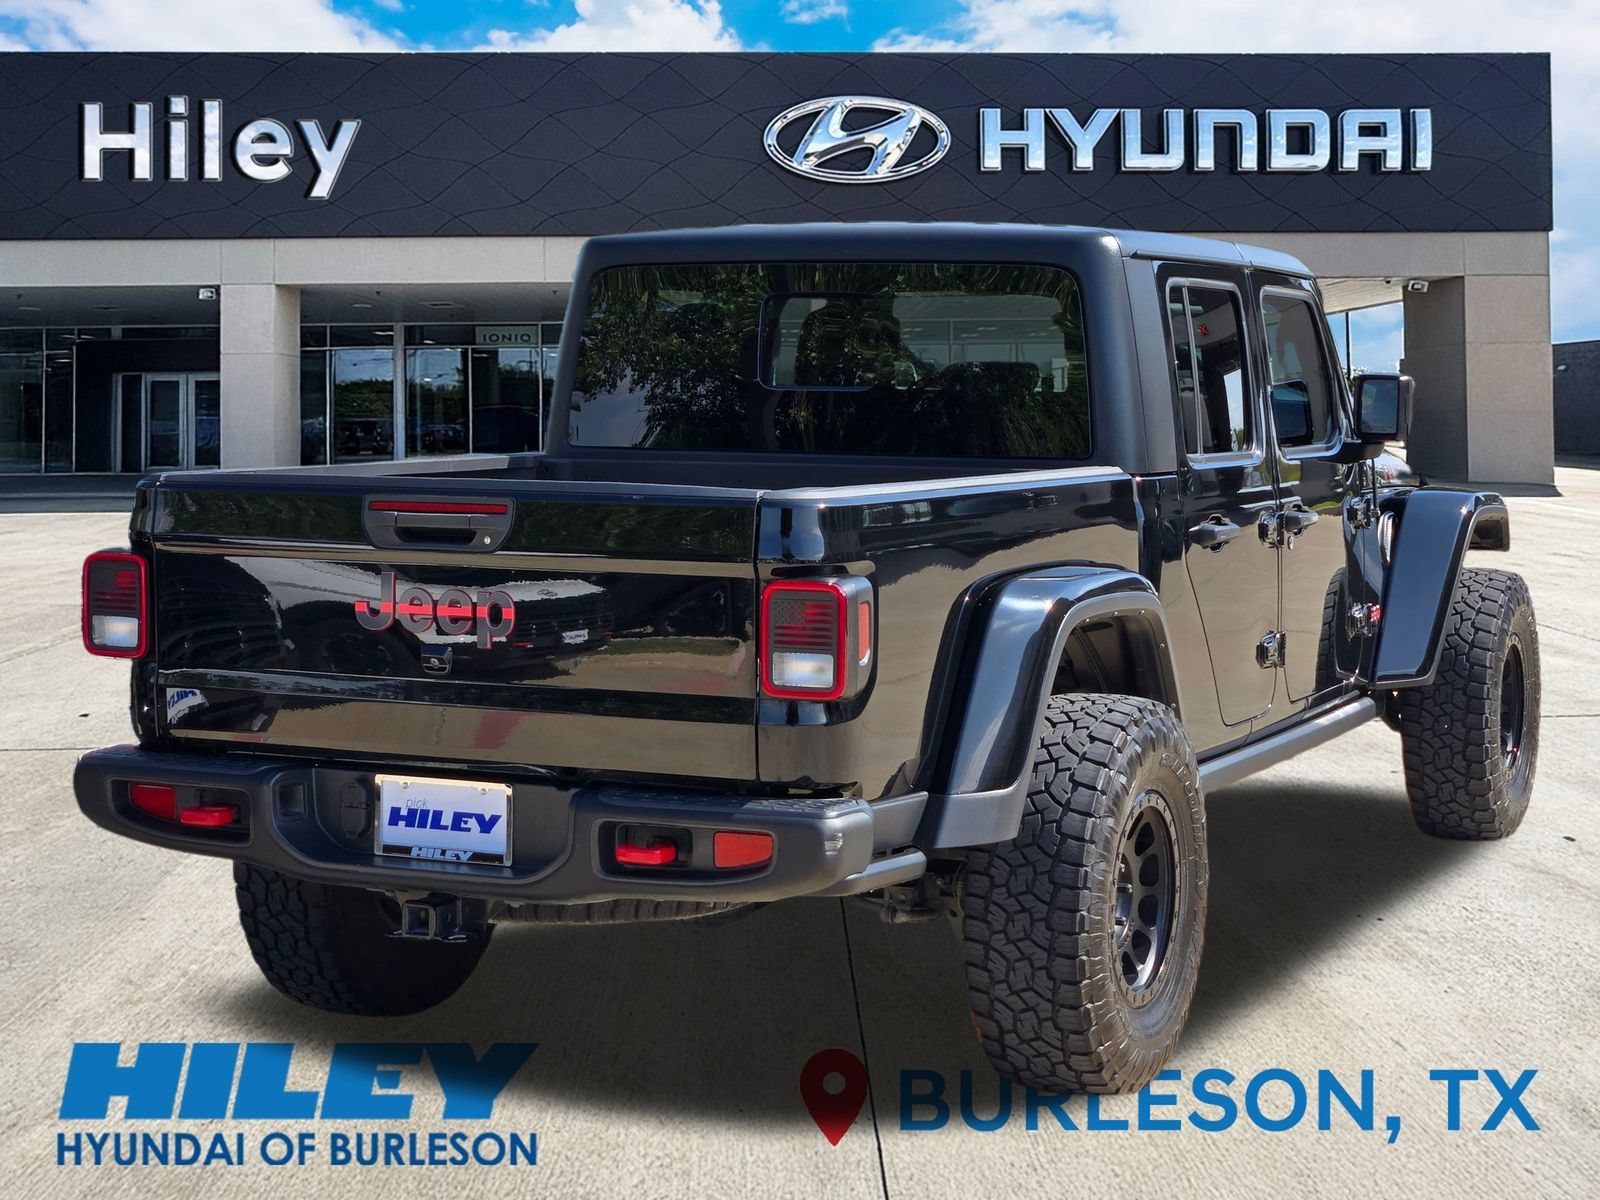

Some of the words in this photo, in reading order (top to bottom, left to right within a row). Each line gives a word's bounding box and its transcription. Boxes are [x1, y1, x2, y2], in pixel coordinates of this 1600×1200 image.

[81, 95, 361, 199] Hiley
[980, 108, 1432, 172] HYUNDAI
[355, 569, 516, 649] Jeep
[388, 806, 502, 834] HILEY
[405, 797, 429, 809] pick
[410, 846, 474, 862] HILEY
